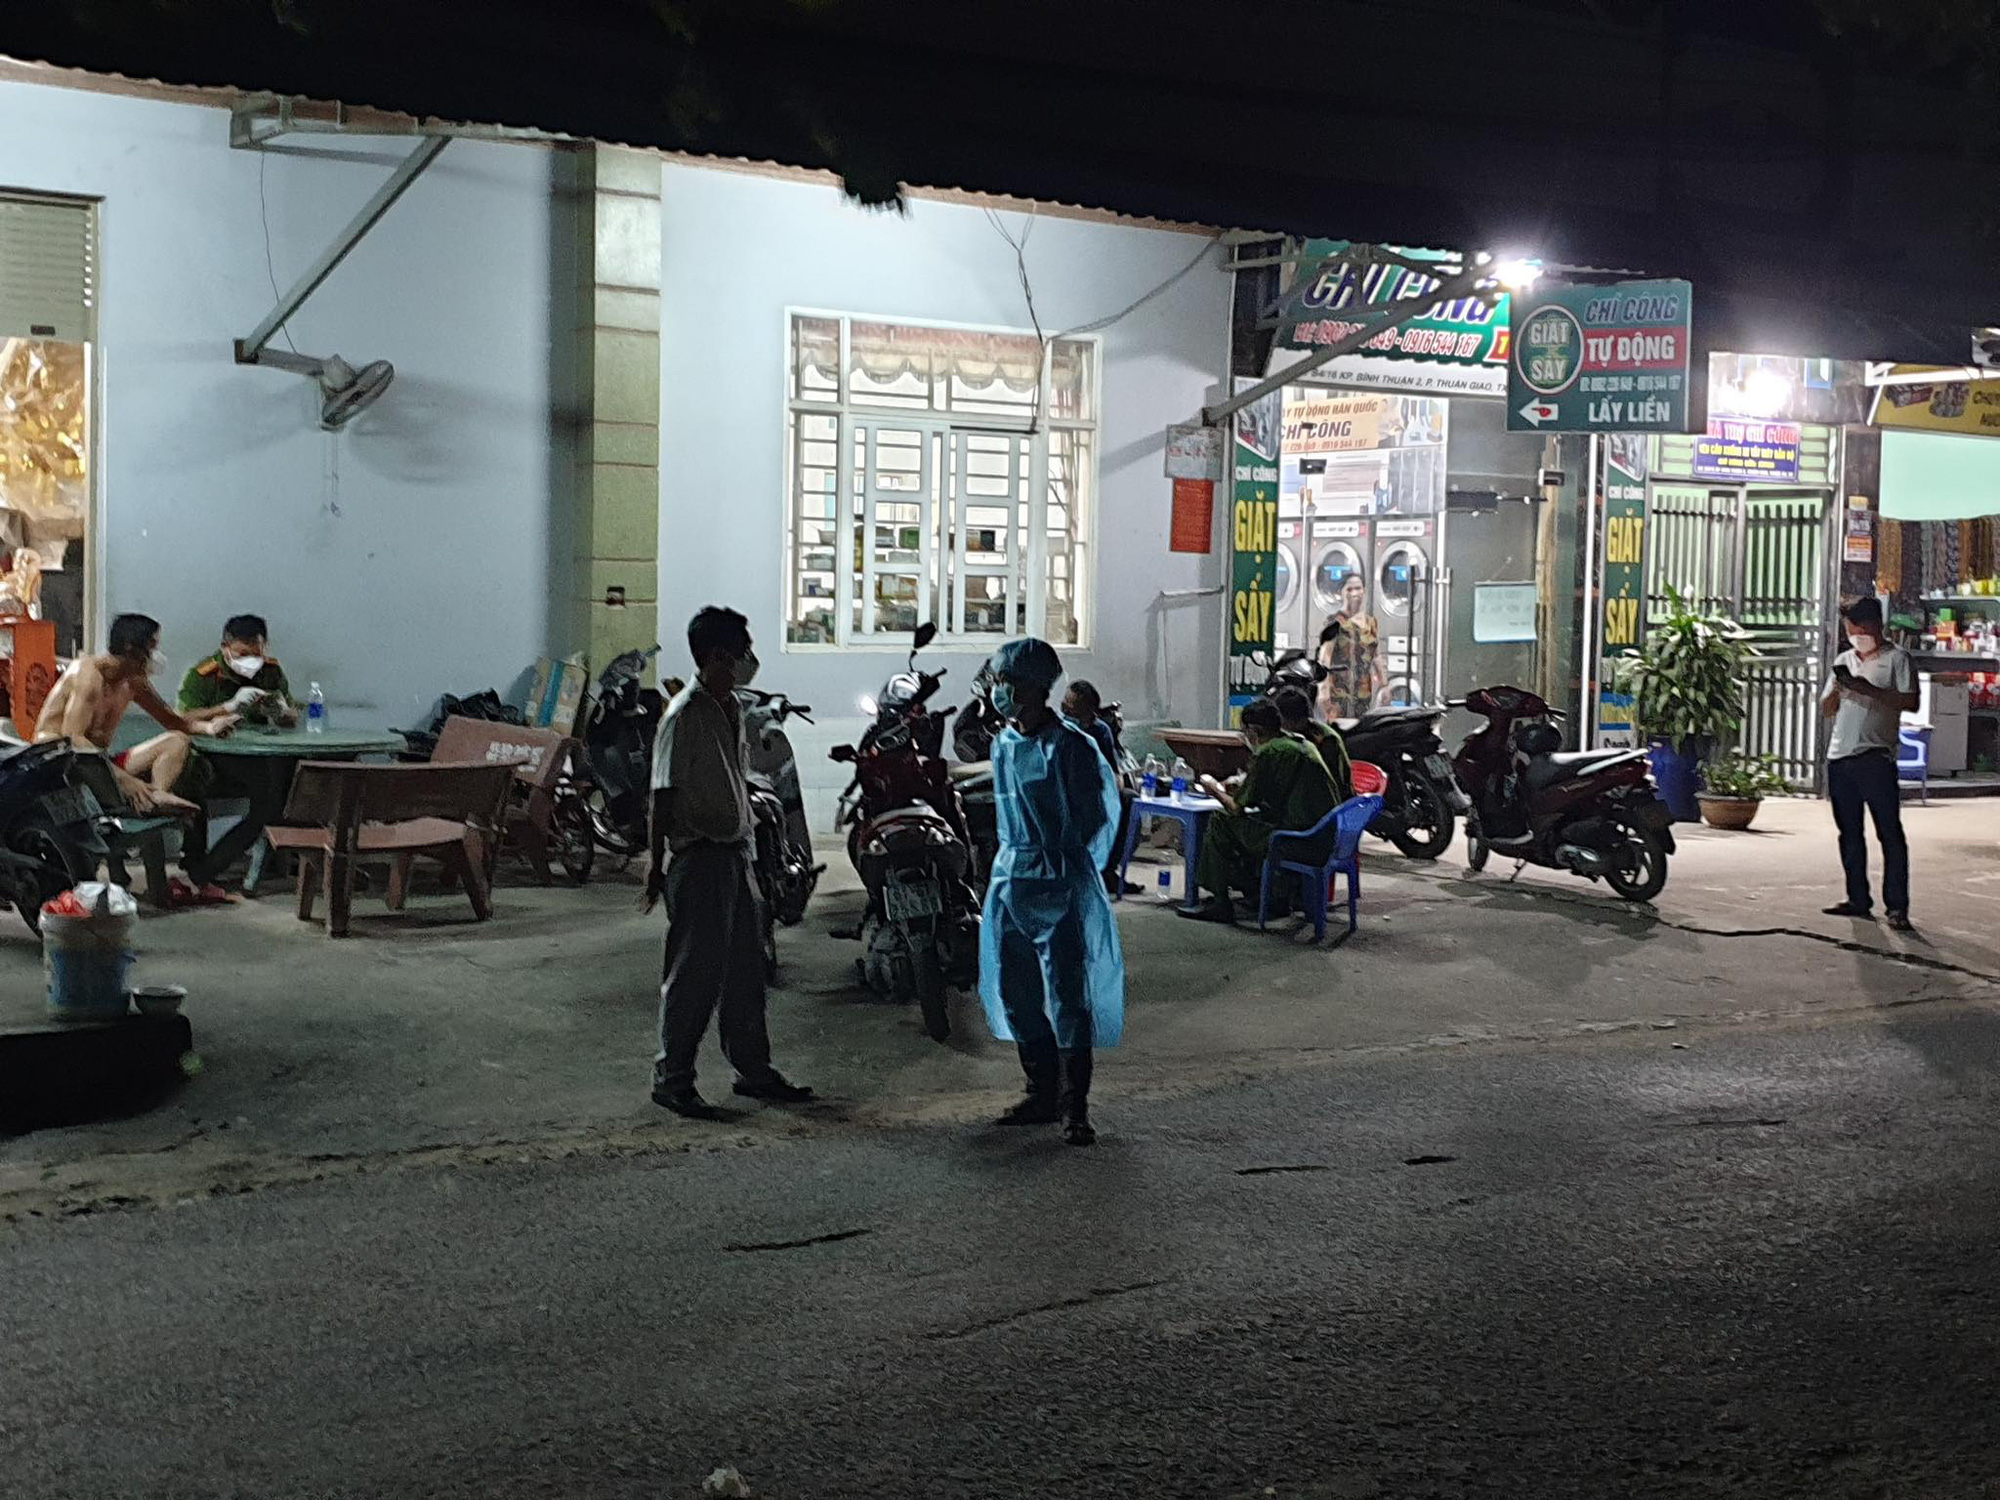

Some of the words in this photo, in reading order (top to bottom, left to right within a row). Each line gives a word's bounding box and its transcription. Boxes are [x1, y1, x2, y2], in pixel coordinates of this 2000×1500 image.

[1622, 291, 1680, 323] CÔNG
[1401, 328, 1434, 353] 0916
[1431, 331, 1458, 355] 544
[1455, 333, 1483, 357] 167
[1587, 335, 1615, 367] TỰ
[1617, 331, 1675, 366] ĐỘNG
[1588, 394, 1623, 422] LẤY
[1234, 489, 1276, 563] GIẶT
[1606, 507, 1643, 574] GIẶT
[1234, 572, 1272, 643] SẤY
[1605, 581, 1638, 644] SẤY
